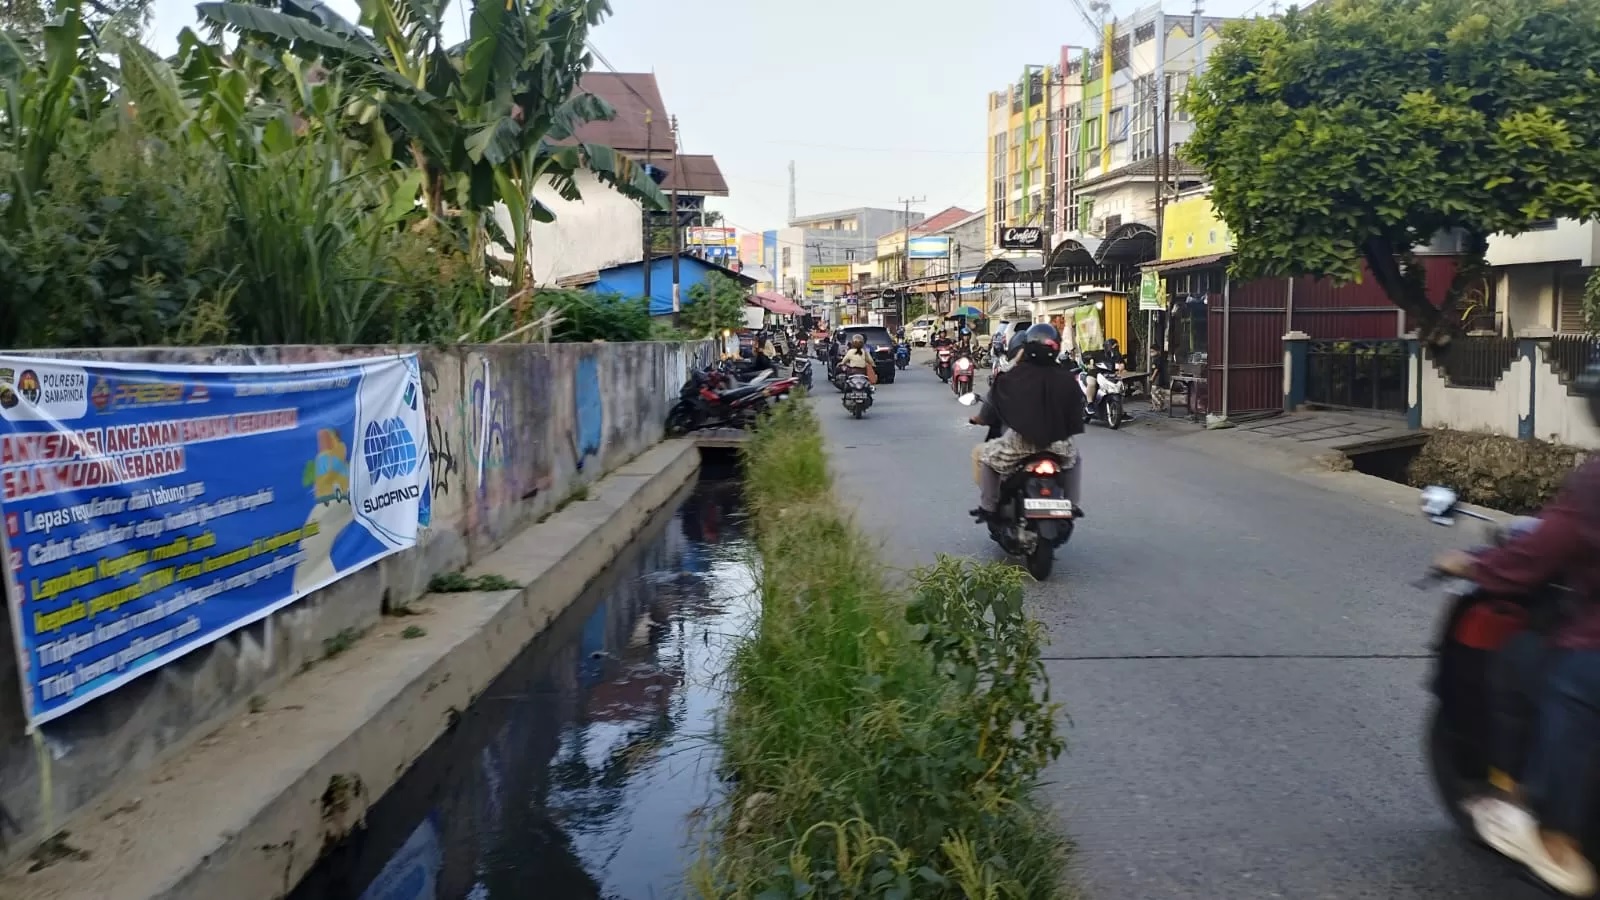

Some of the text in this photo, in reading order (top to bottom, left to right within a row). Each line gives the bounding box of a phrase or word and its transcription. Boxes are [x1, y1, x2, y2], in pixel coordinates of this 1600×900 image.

[44, 374, 84, 388] POLRESTA
[45, 389, 84, 404] SAMARINDA
[108, 421, 178, 452] ANCAMAN
[4, 464, 54, 498] SAA
[119, 448, 184, 481] LEBARAN
[24, 507, 70, 534] Lepas
[152, 485, 185, 505] tabung
